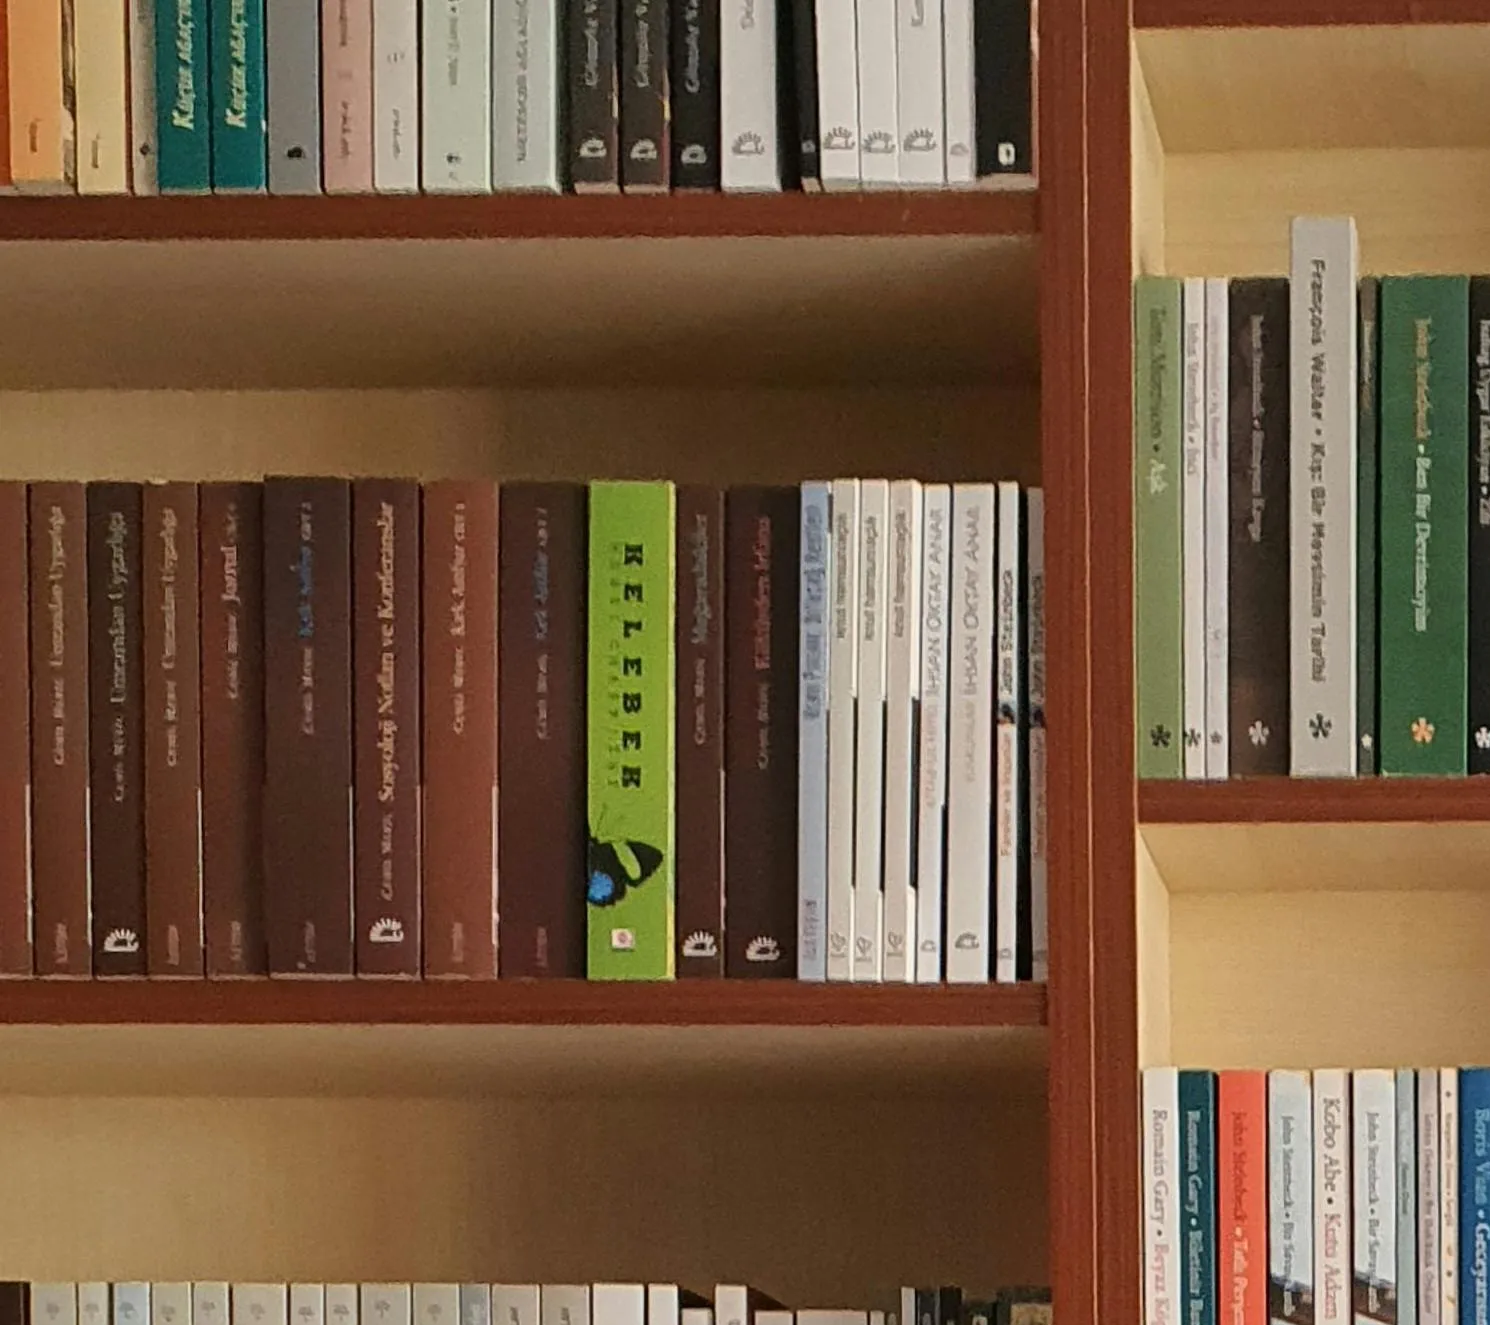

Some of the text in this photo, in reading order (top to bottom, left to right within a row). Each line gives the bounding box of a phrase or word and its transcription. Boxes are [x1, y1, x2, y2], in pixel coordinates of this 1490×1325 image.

[1311, 355, 1327, 420] Walter
[1311, 486, 1326, 515] Bir
[621, 543, 644, 788] KELEBEK
[1311, 624, 1326, 682] Tarihi
[1323, 1098, 1342, 1148] Kobo
[1323, 1152, 1341, 1190] Abe
